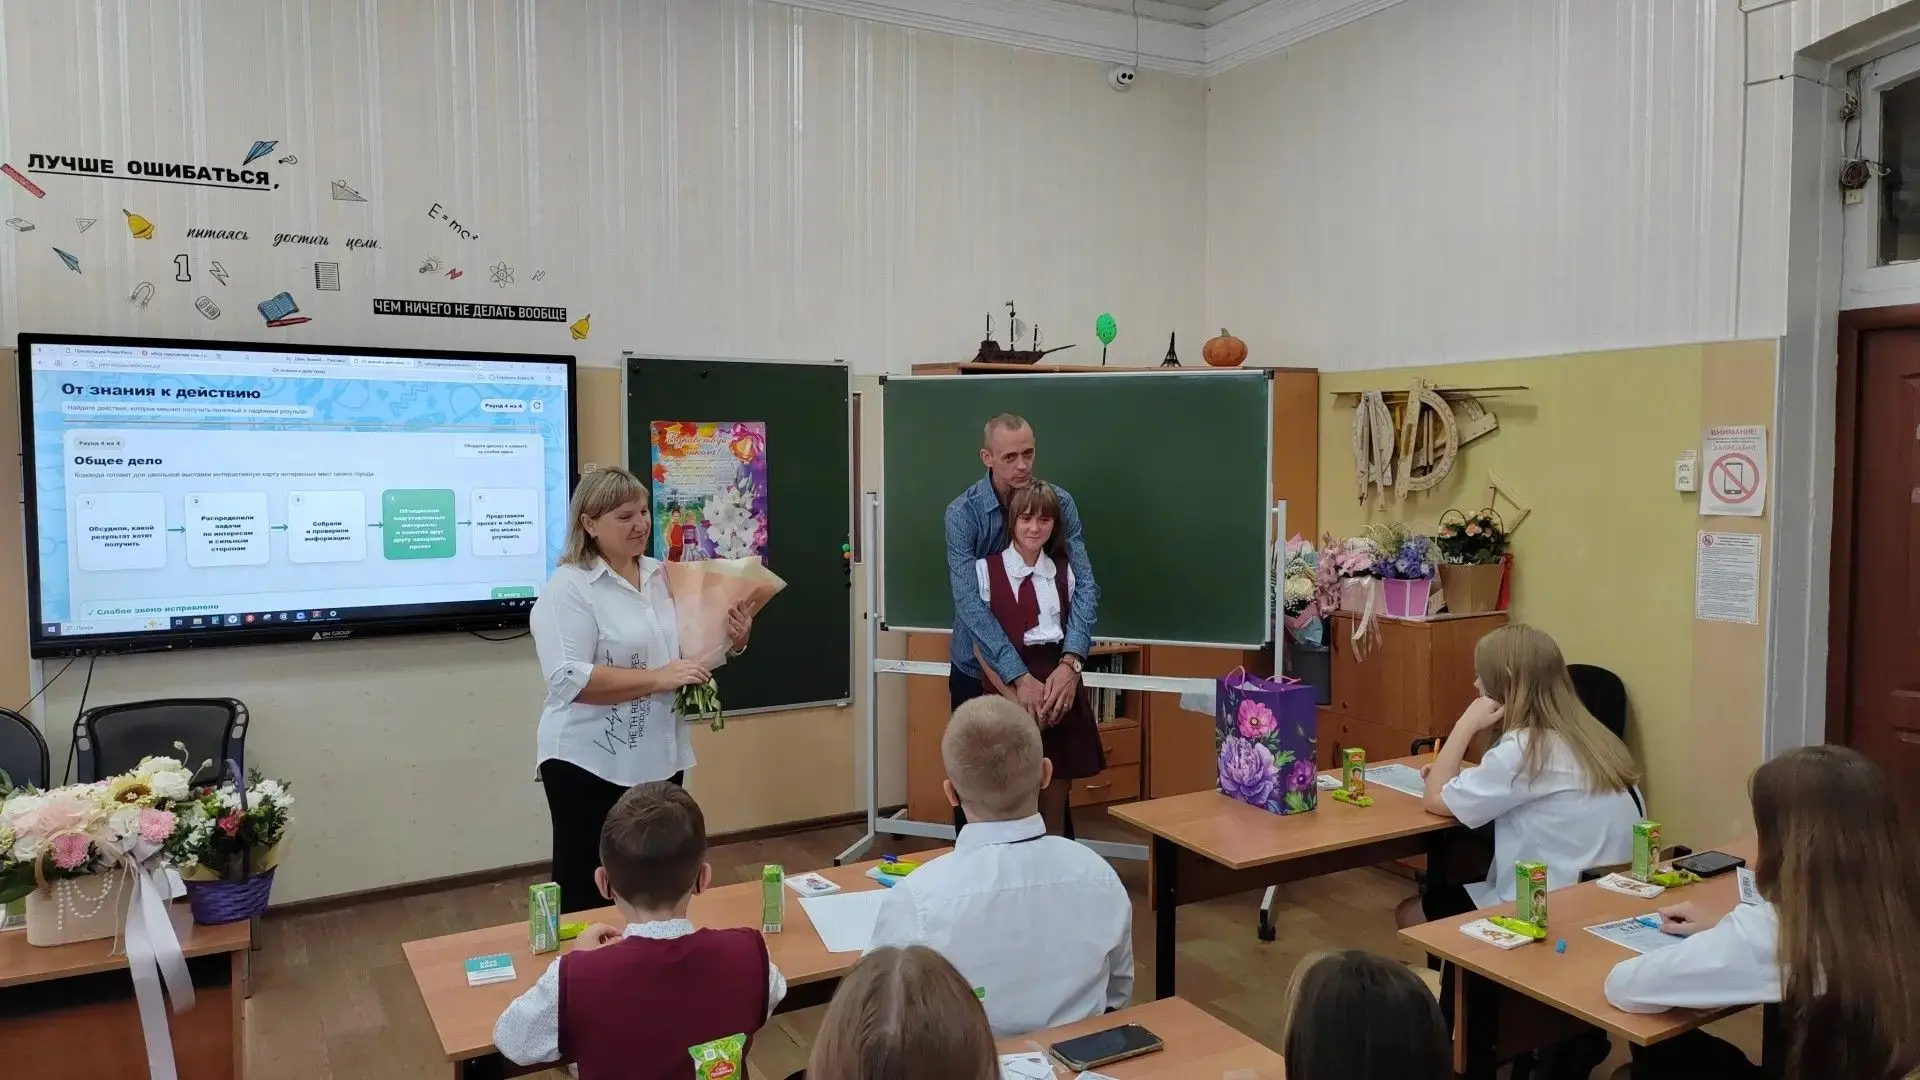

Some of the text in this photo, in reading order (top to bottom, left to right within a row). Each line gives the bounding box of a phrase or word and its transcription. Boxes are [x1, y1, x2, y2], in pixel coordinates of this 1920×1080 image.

[28, 153, 279, 189] ЛУЧШЕ ОШИБАТЬСЯ,
[186, 227, 249, 241] пытаясь
[272, 231, 330, 247] достичь
[374, 300, 567, 321] ЧЕМ НИЧЕГО НЕ ДЕЛАТЬ ВООБЩЕ
[62, 383, 261, 399] От знания к действию
[1710, 428, 1757, 436] ВНИМАНИЕ!
[74, 456, 163, 467] Общее дело
[88, 525, 130, 533] Обсудили,
[96, 603, 220, 616] Слабое звено исправлено
[629, 730, 638, 750] THE
